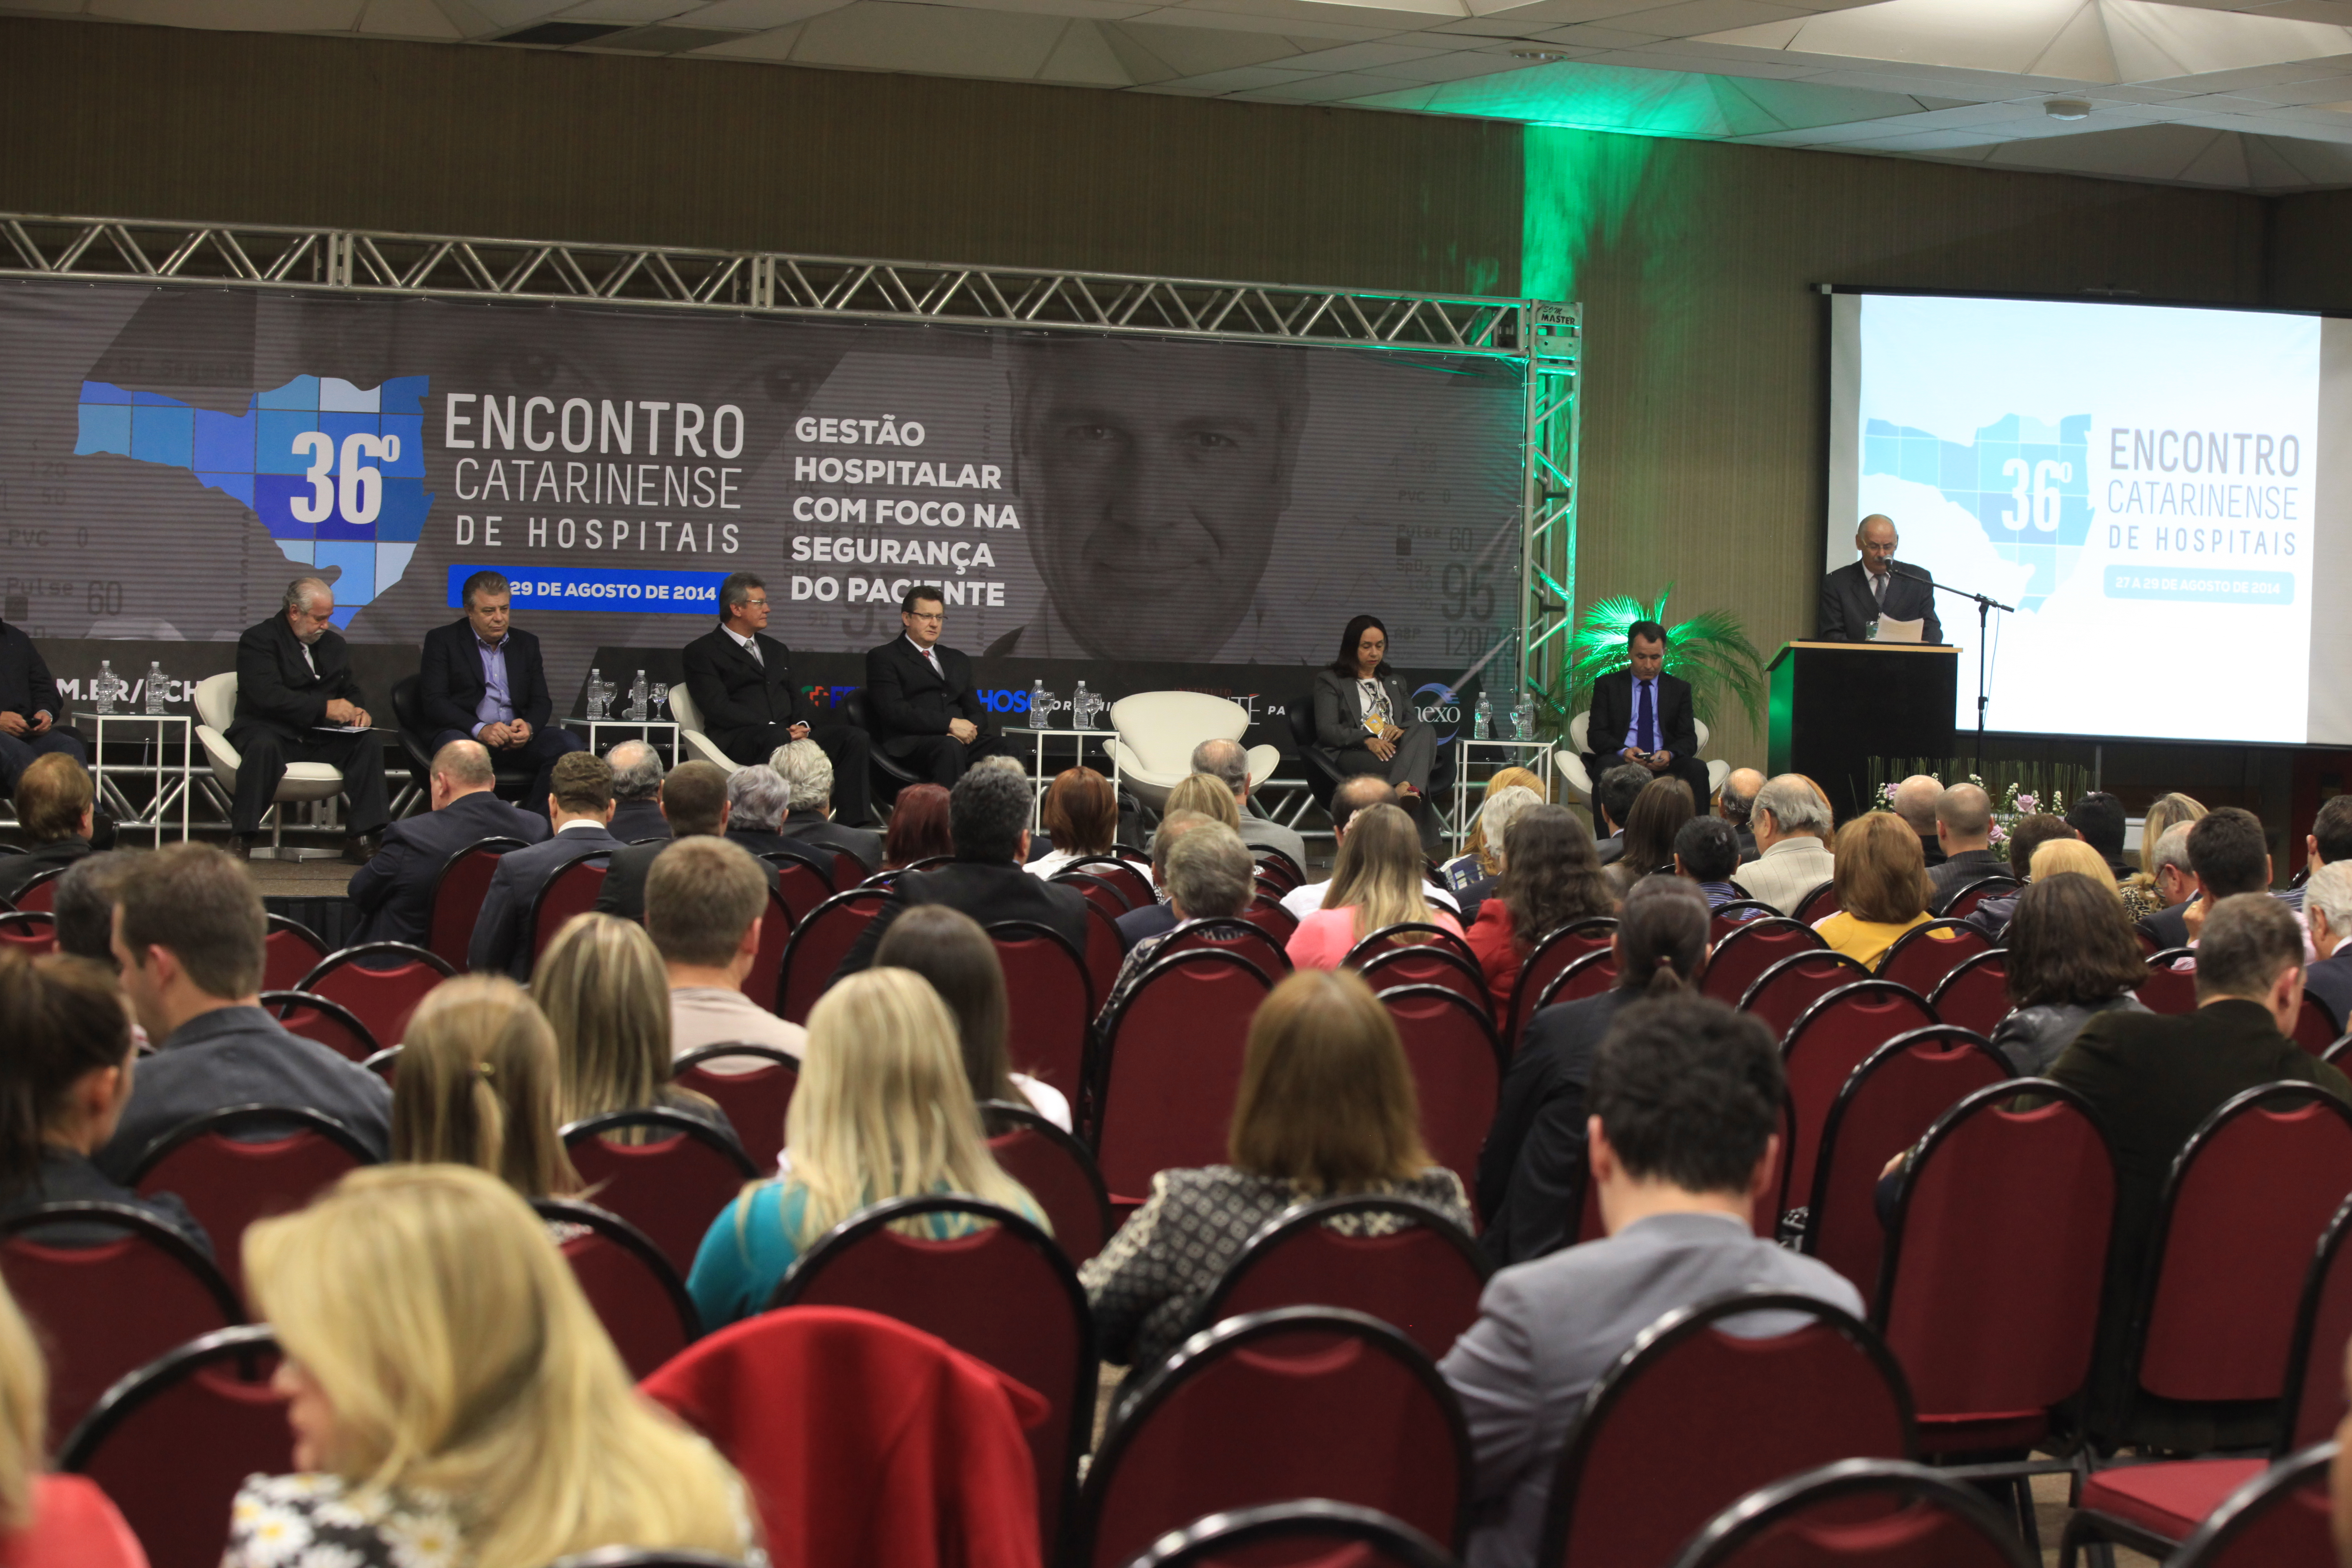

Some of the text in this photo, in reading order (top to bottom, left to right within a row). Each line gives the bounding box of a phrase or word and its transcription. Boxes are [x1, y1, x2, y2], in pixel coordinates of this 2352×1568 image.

[1541, 314, 1575, 325] MASTER
[446, 393, 744, 459] ENCONTRO
[795, 414, 925, 446] GESTÃO
[2111, 428, 2299, 477] ENCONTRO
[455, 458, 742, 509] CATARINENSE
[795, 456, 1002, 489] HOSPITALAR
[793, 496, 1021, 529] COM FOCO NA
[2108, 480, 2298, 520] CATARINENSE
[456, 515, 739, 554] DE HOSPITAIS
[2110, 525, 2296, 556] DE HOSPITAIS
[792, 536, 995, 575] SEGURANÇA
[510, 581, 717, 601] 29 DE AGOSTO DE 2014
[791, 575, 1005, 606] DO PACNTE
[2115, 577, 2281, 594] 27 A 29 DE AGOSTO DE 2014
